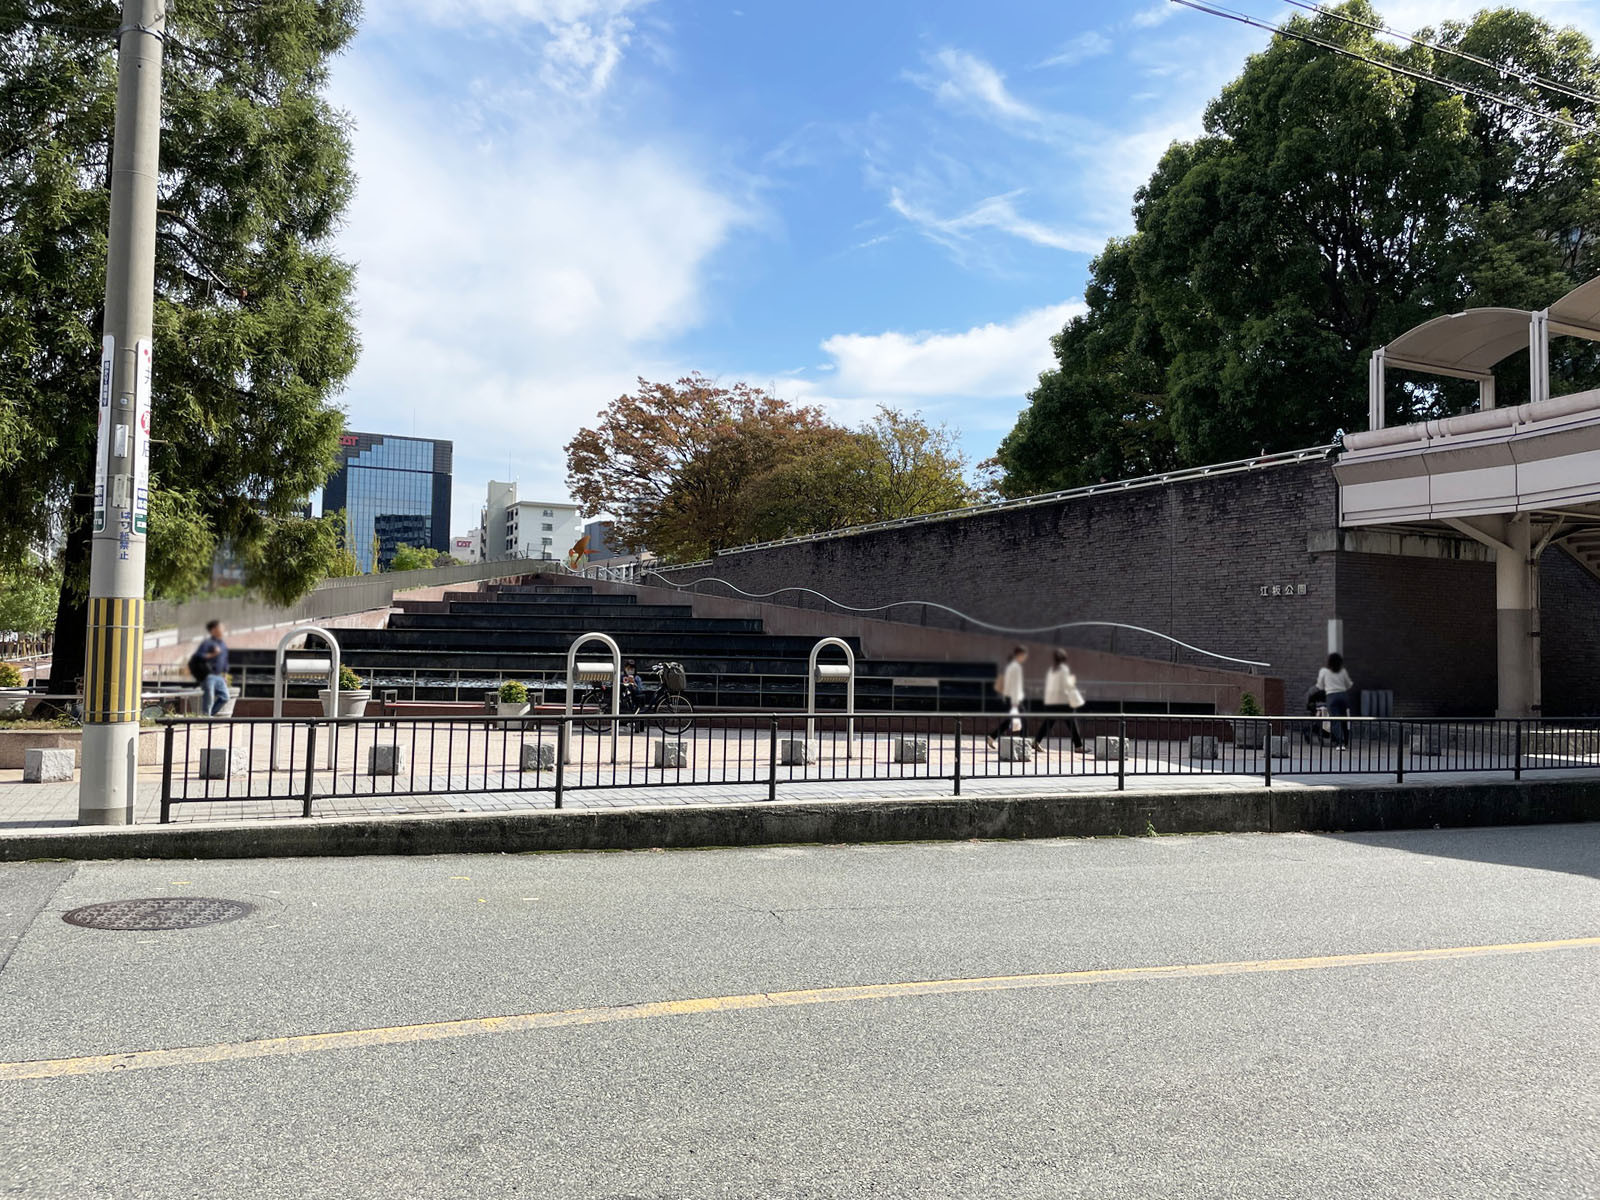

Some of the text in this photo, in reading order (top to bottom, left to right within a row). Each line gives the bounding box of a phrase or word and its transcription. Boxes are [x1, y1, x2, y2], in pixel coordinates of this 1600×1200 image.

[119, 511, 131, 560] はり紙禁止
[1260, 584, 1307, 597] 江坂公園
